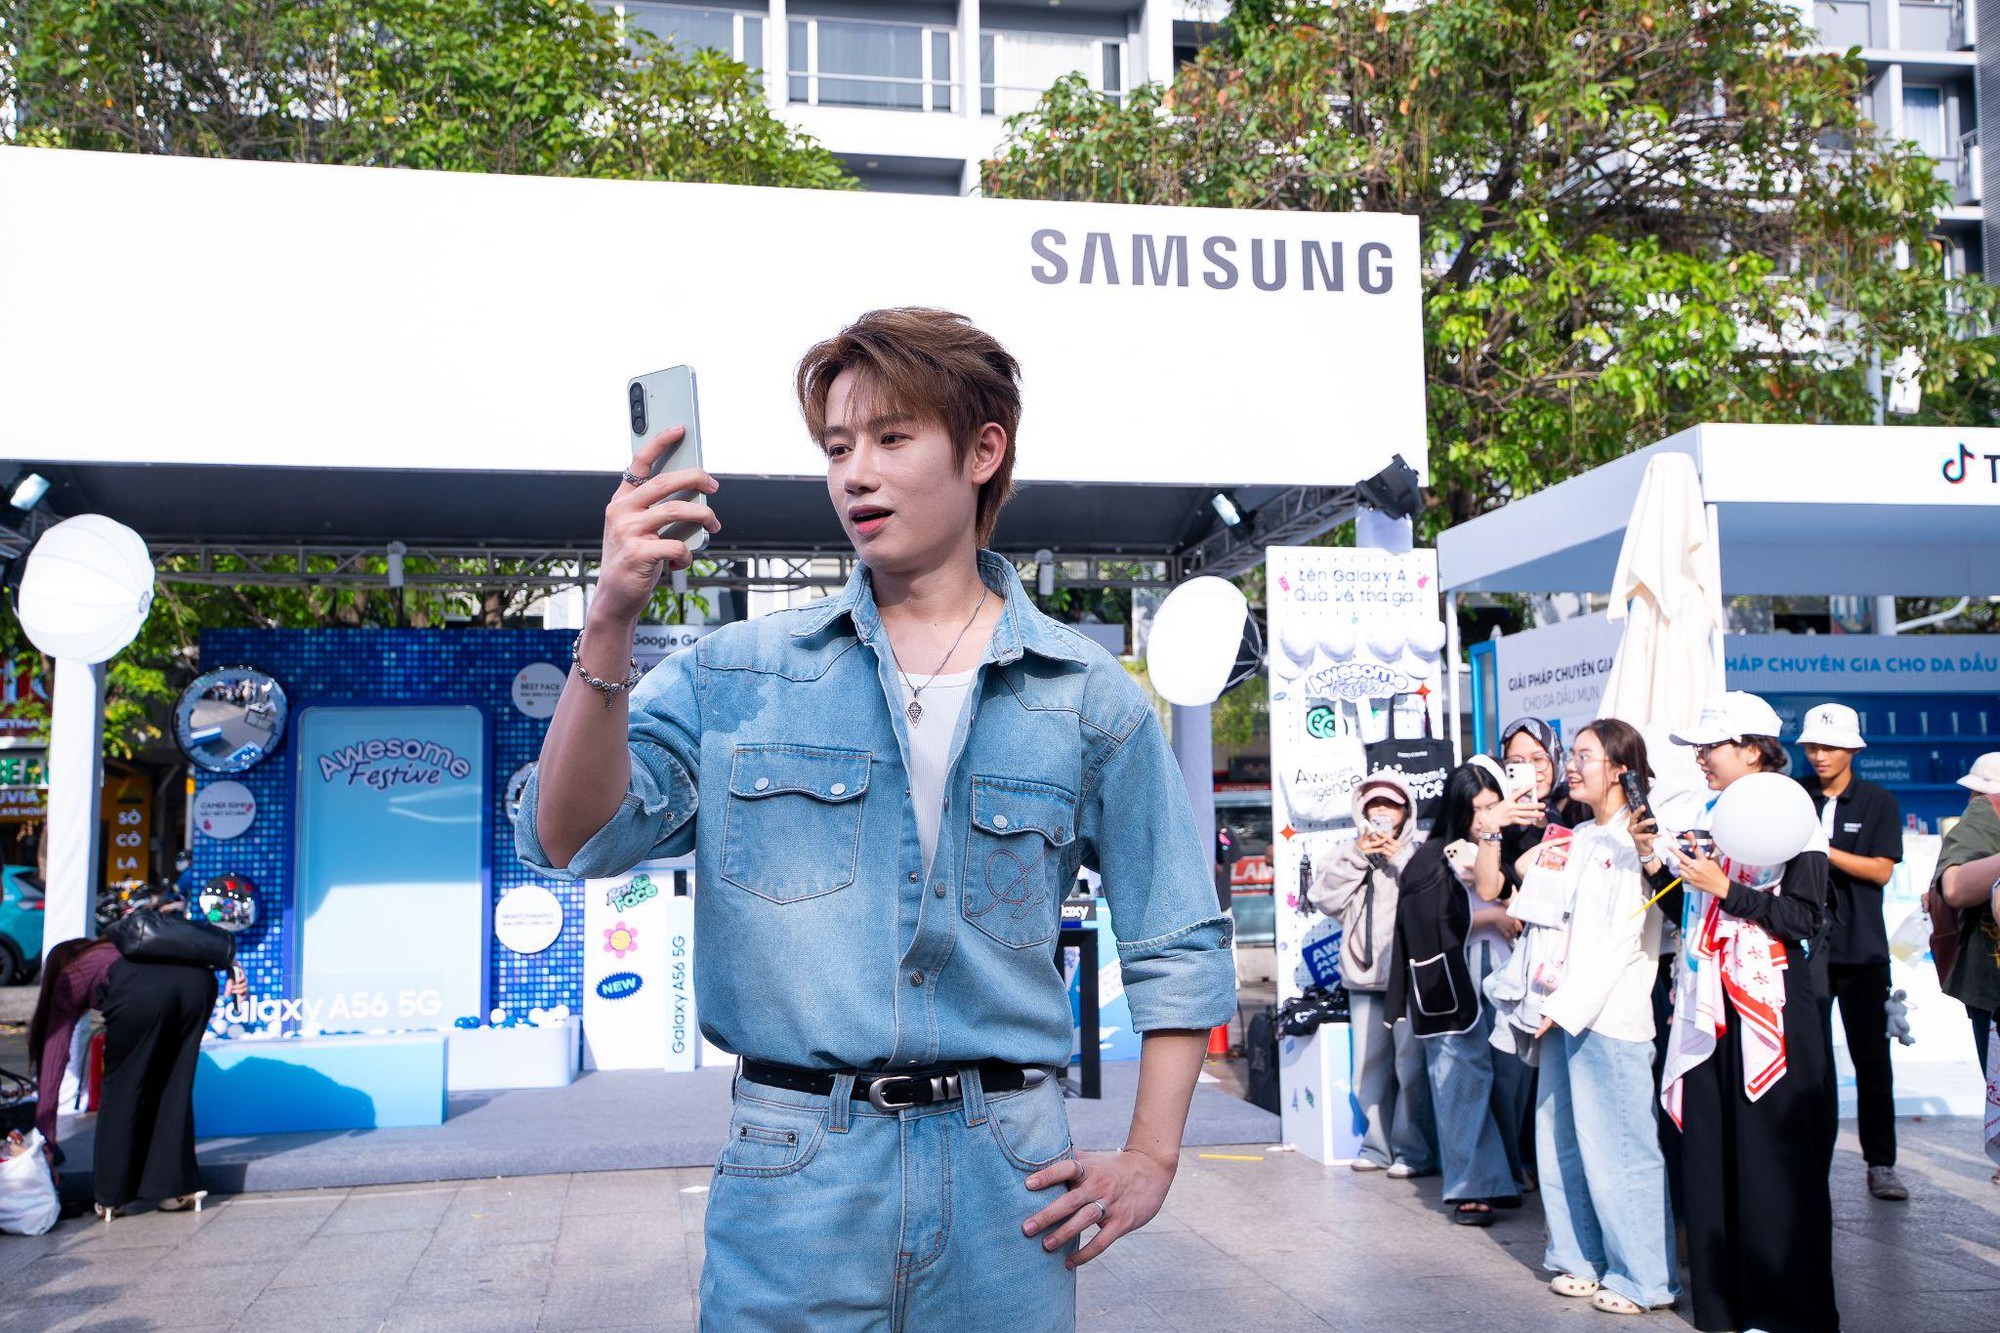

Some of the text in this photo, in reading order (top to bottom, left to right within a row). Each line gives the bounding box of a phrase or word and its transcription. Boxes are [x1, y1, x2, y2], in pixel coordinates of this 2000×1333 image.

[1031, 228, 1394, 295] SAMSUNG
[1333, 568, 1392, 586] Galaxy
[1725, 652, 1764, 673] HÁP
[1767, 654, 1845, 673] CHUYÊN
[1850, 657, 1882, 673] GIA
[1886, 657, 1926, 673] CHO
[1931, 657, 1955, 673] DA
[317, 737, 472, 783] Awesome
[348, 761, 441, 790] Festive
[117, 857, 139, 870] LA
[1061, 905, 1090, 920] laxy
[602, 977, 637, 995] NEW
[672, 935, 688, 1054] Galaxy A56 5G
[328, 991, 389, 1020] A56
[397, 988, 444, 1018] 5G
